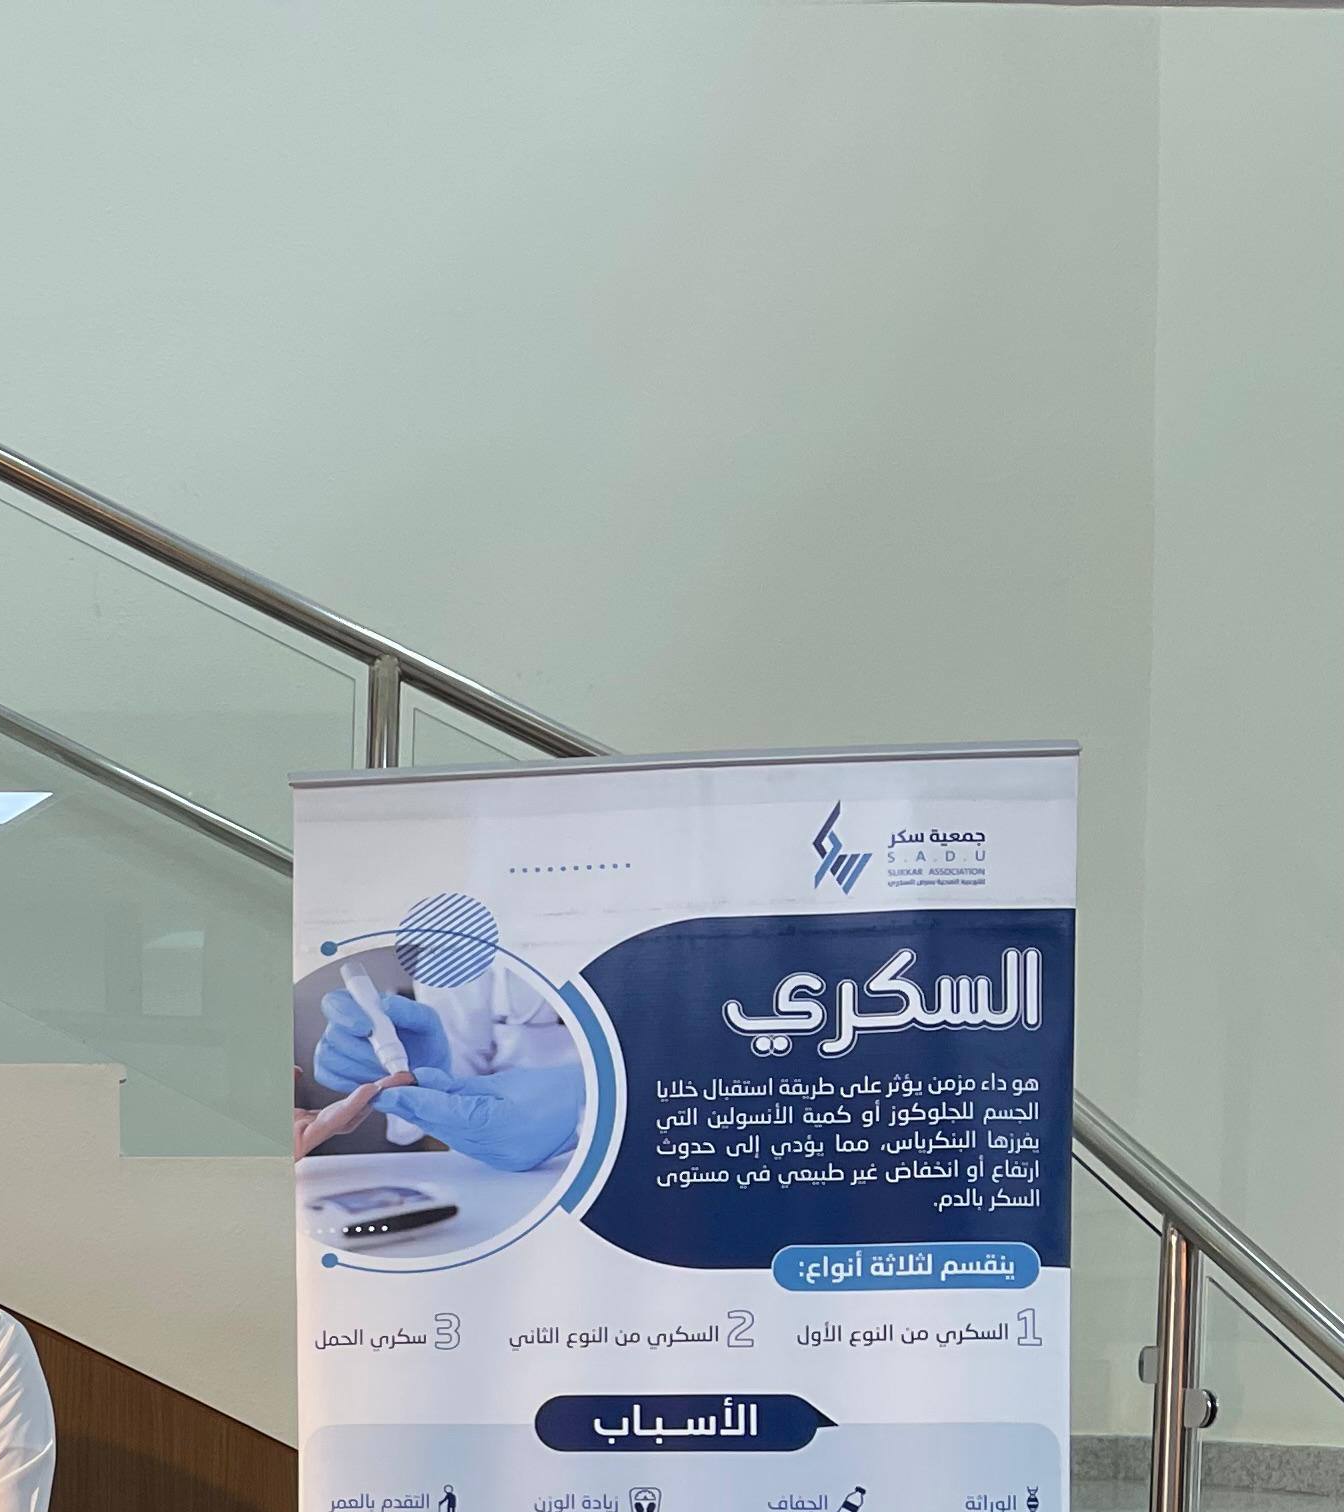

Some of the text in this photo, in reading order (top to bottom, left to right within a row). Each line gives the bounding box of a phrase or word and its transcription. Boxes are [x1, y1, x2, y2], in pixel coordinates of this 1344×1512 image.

[888, 829, 985, 848] جمعية سكر
[722, 948, 1042, 1058] السكري
[658, 1073, 1038, 1102] هو داء مزمن يؤثر على طريقة استقبال خلايا
[657, 1100, 1038, 1133] الجسم للجلوكوز أو كمية الأنسولين التي
[657, 1138, 715, 1159] حدوث
[726, 1135, 759, 1158] إلى
[771, 1135, 824, 1160] يؤدي
[836, 1134, 868, 1152] مما
[988, 1131, 1039, 1153] يفرزها
[657, 1155, 1039, 1189] ارتفاع أو انخفاض غير طبيعي في مستوى
[934, 1188, 1039, 1212] السكر بالدم.
[800, 1250, 1014, 1283] ينقسم لثلاثة أنواع:
[315, 1313, 460, 1352] 3 سكري الحمل
[510, 1310, 754, 1349] 2 السكري من النوع الثاني
[797, 1308, 1042, 1347] 1 السكري من النوع الأول
[594, 1397, 757, 1444] الأسباب
[330, 1494, 429, 1512] التقدم بالعمر
[534, 1494, 618, 1512] زيادة الوزن
[768, 1495, 827, 1510] الجفاف
